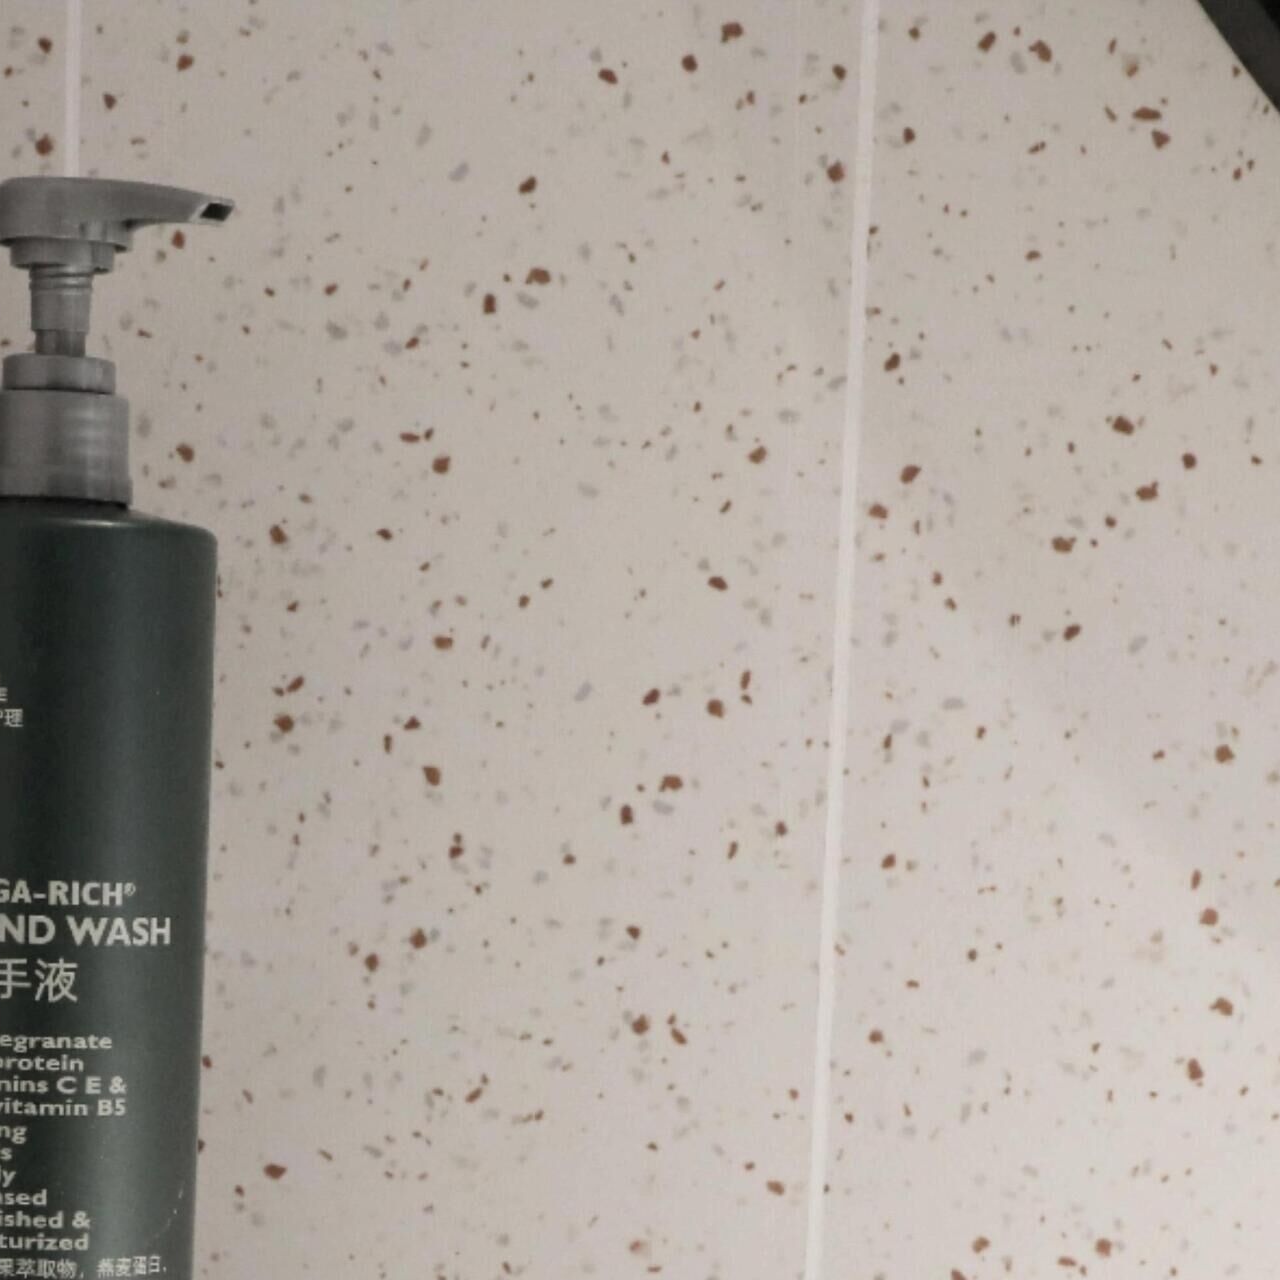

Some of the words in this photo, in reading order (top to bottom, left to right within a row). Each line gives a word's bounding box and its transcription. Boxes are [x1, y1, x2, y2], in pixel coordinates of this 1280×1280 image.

[65, 915, 171, 947] WASH
[56, 1075, 77, 1095] C
[84, 1076, 102, 1095] E
[108, 1075, 127, 1095] &
[97, 1098, 126, 1117] B5
[71, 1210, 91, 1229] &
